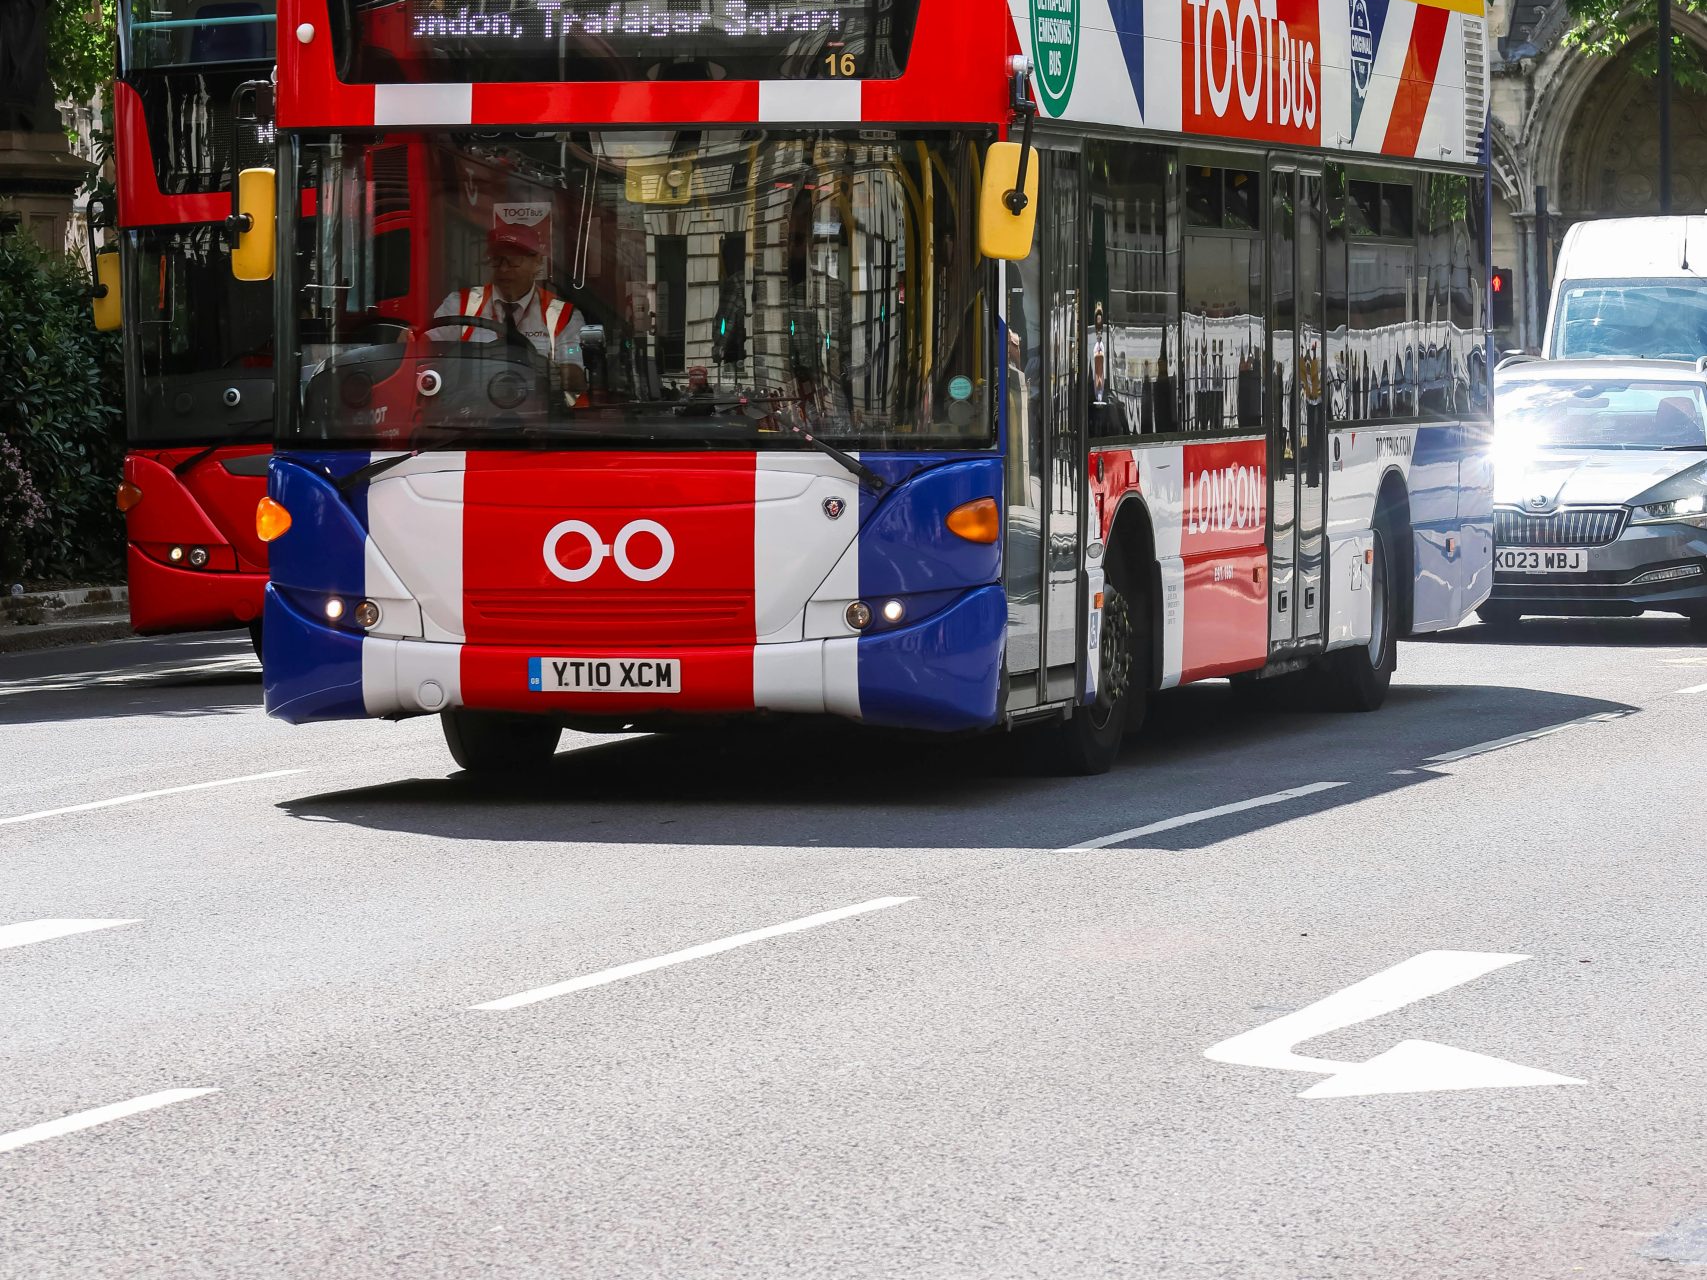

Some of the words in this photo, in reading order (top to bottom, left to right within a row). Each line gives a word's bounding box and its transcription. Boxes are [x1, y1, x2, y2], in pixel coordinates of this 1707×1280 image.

[537, 2, 712, 37] Trafalgar
[724, 0, 839, 36] Squar
[1038, 17, 1072, 45] EMISSIONS
[825, 52, 856, 77] 16
[1048, 50, 1062, 77] BUS
[1375, 435, 1412, 460] TOOTBUS.COM
[1188, 465, 1262, 536] LONDON
[1544, 552, 1580, 570] WBJ
[552, 661, 611, 687] YT10
[619, 662, 672, 688] XCM
